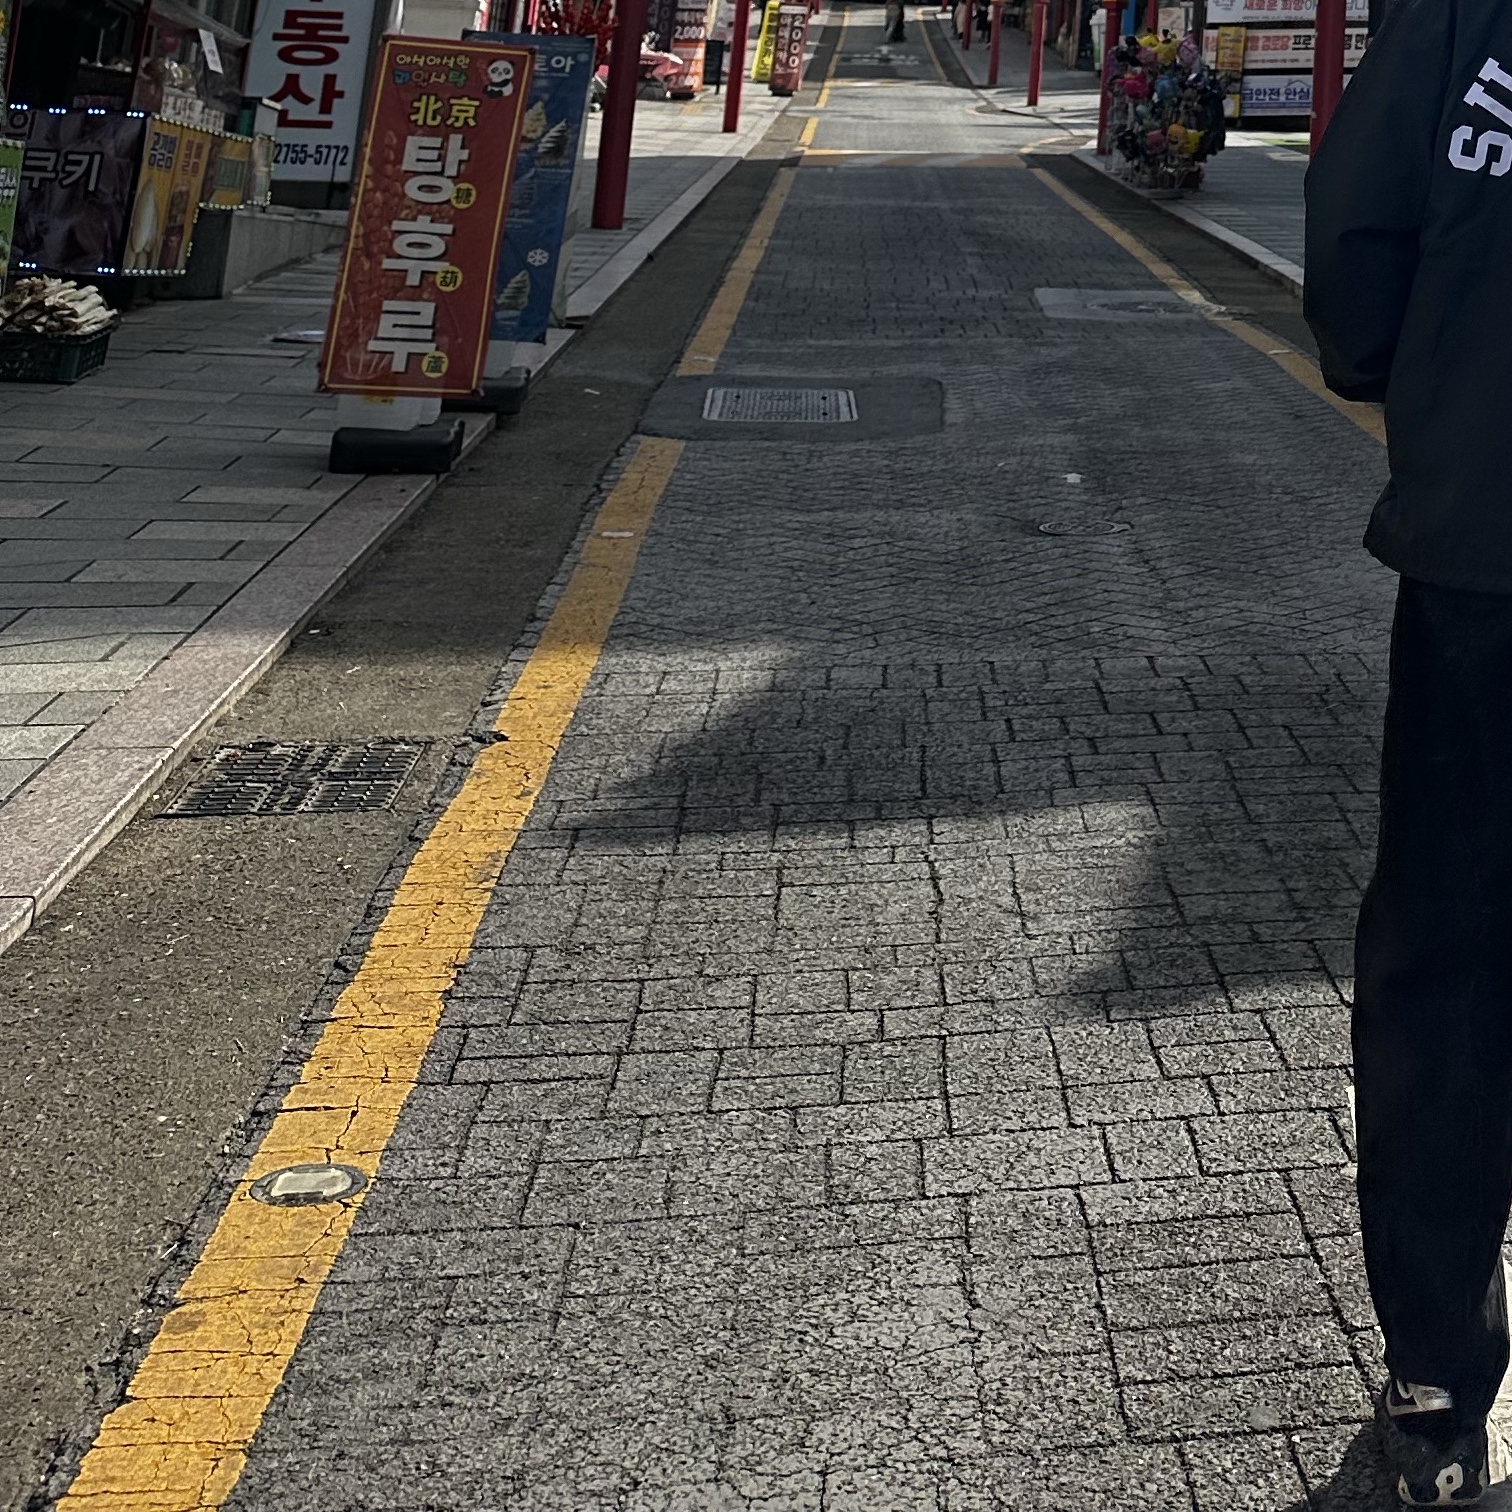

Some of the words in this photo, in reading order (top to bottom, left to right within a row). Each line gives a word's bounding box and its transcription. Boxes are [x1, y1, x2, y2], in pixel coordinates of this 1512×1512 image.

[674, 27, 706, 39] 2,000
[789, 16, 804, 67] 2000
[410, 94, 482, 129] 北京
[22, 147, 104, 194] 쿠키
[367, 134, 471, 373] 탕후루
